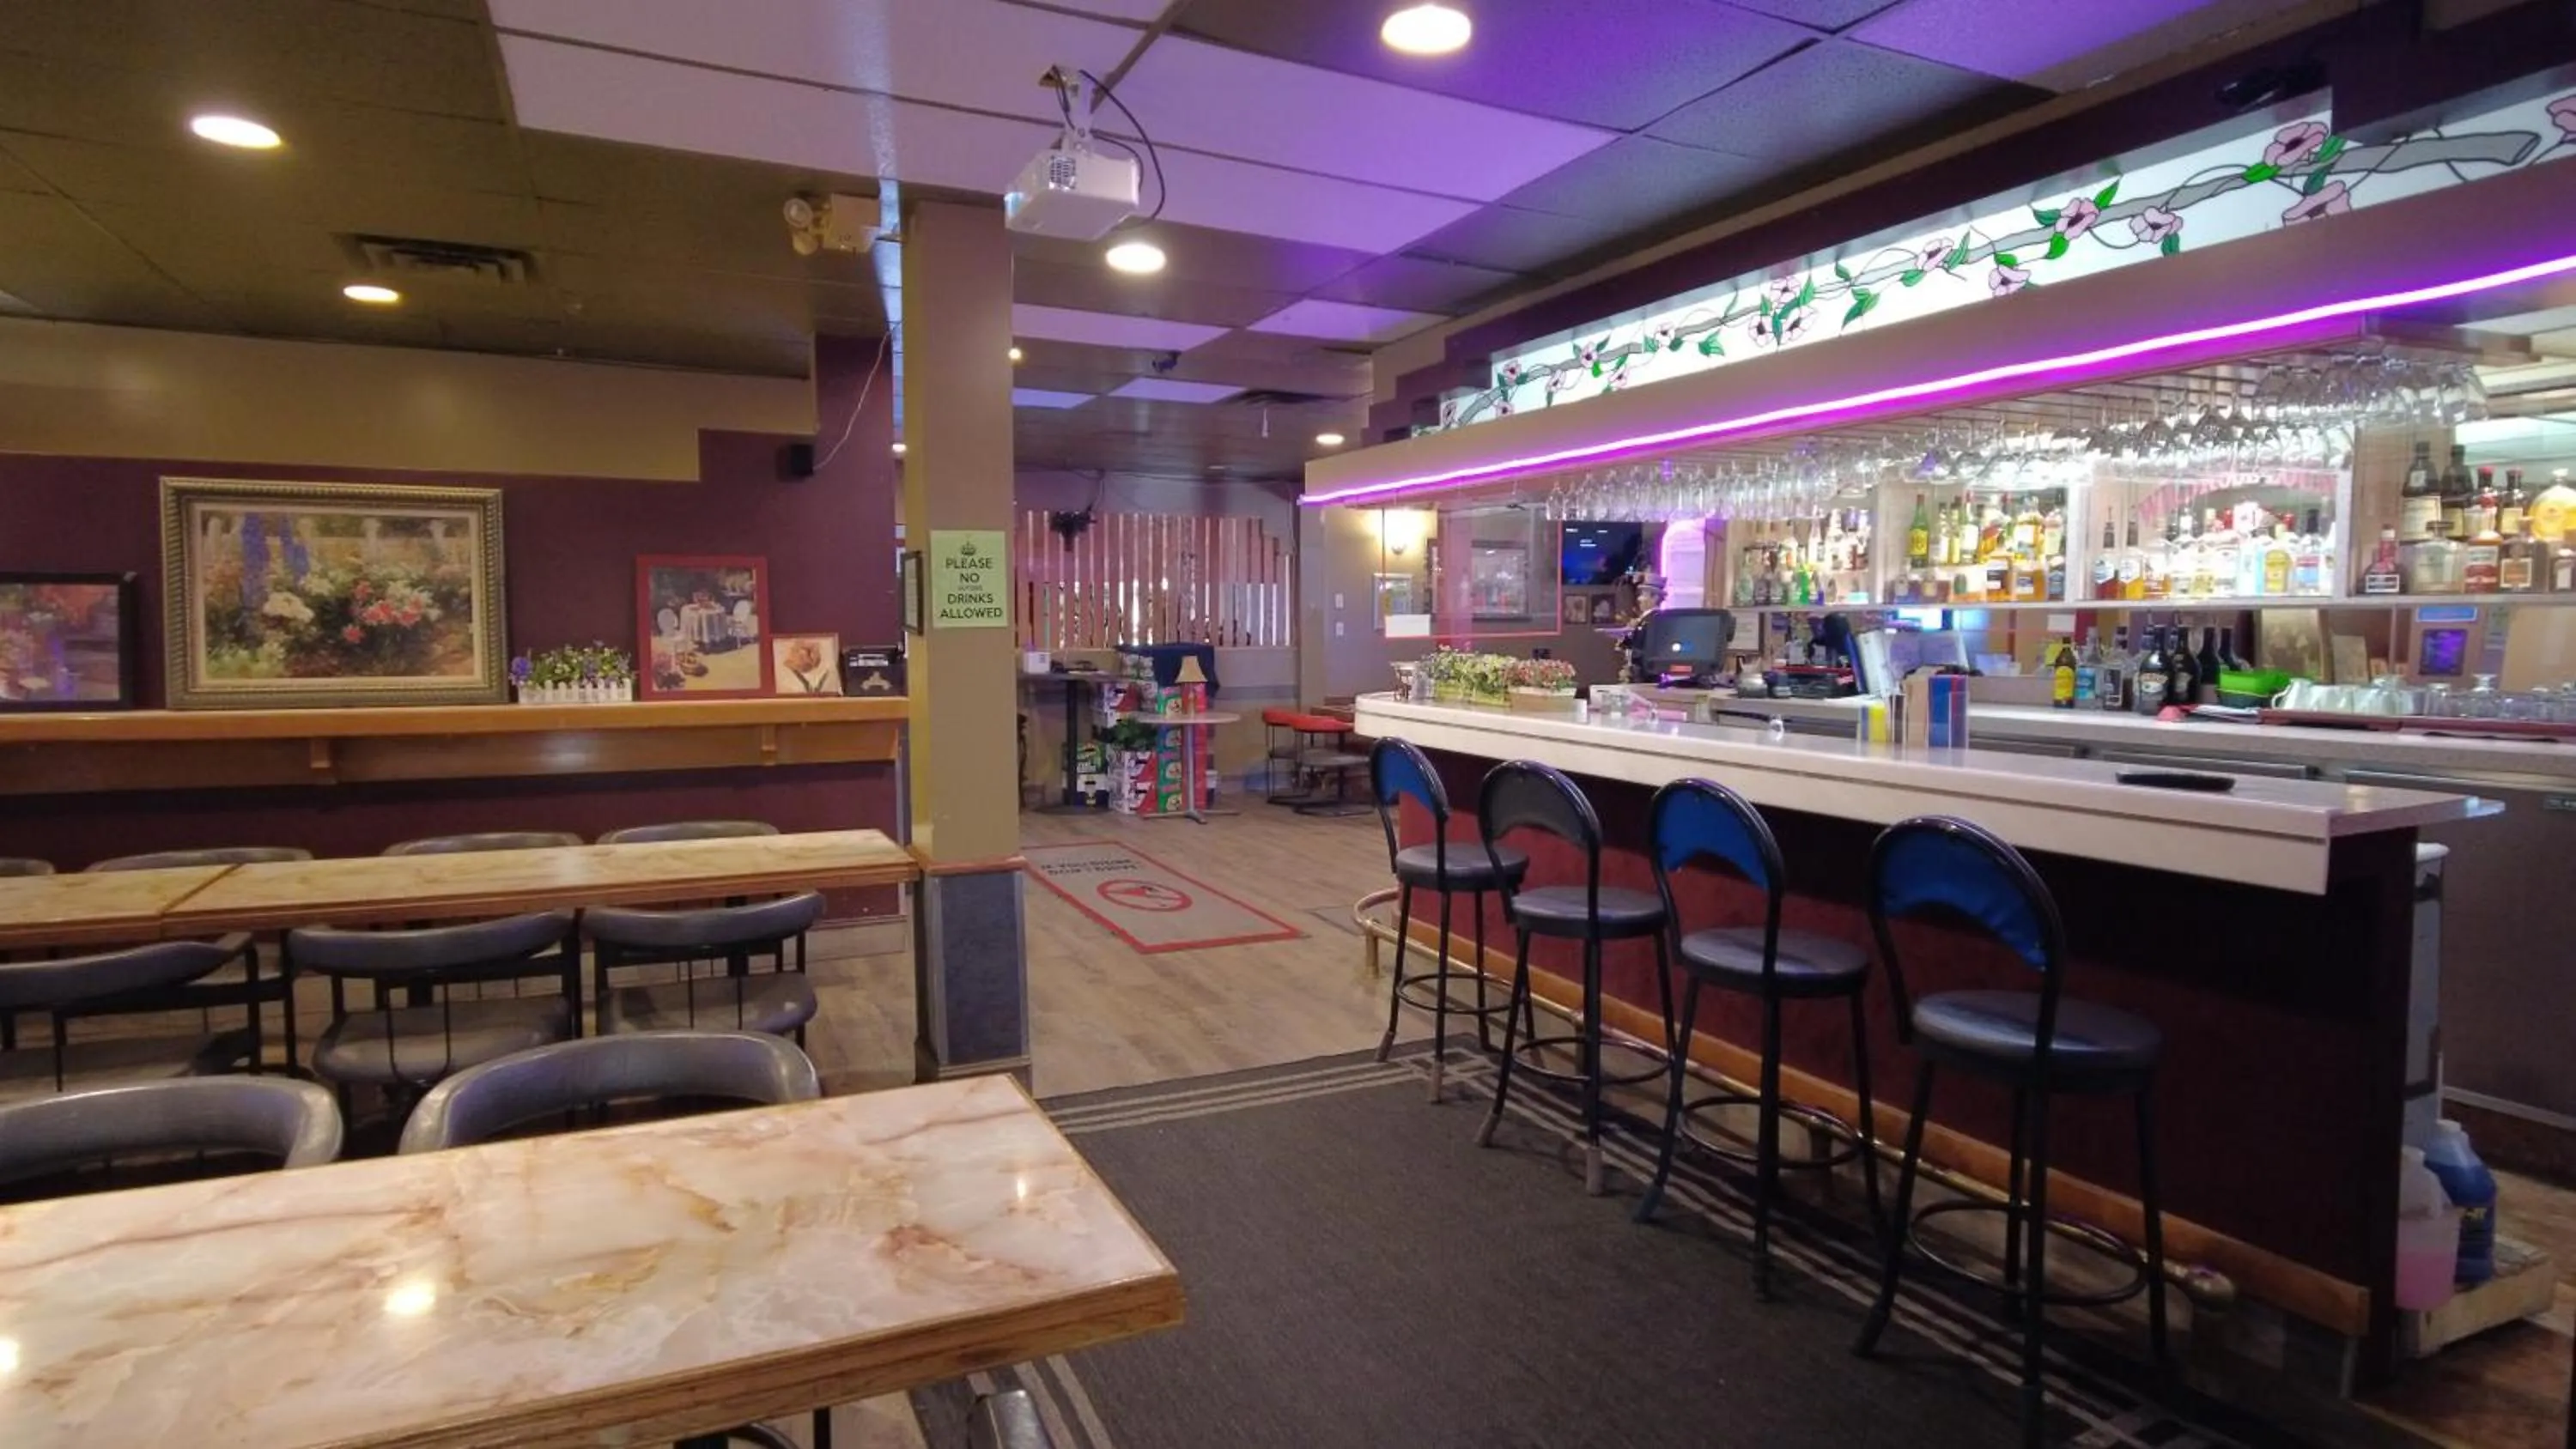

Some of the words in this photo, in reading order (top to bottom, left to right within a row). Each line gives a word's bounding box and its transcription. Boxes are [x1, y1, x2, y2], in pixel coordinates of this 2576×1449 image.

[945, 558, 993, 569] PLEASE
[960, 573, 980, 583] NO
[947, 593, 993, 604] DRINKS
[940, 607, 1003, 618] ALLOWED
